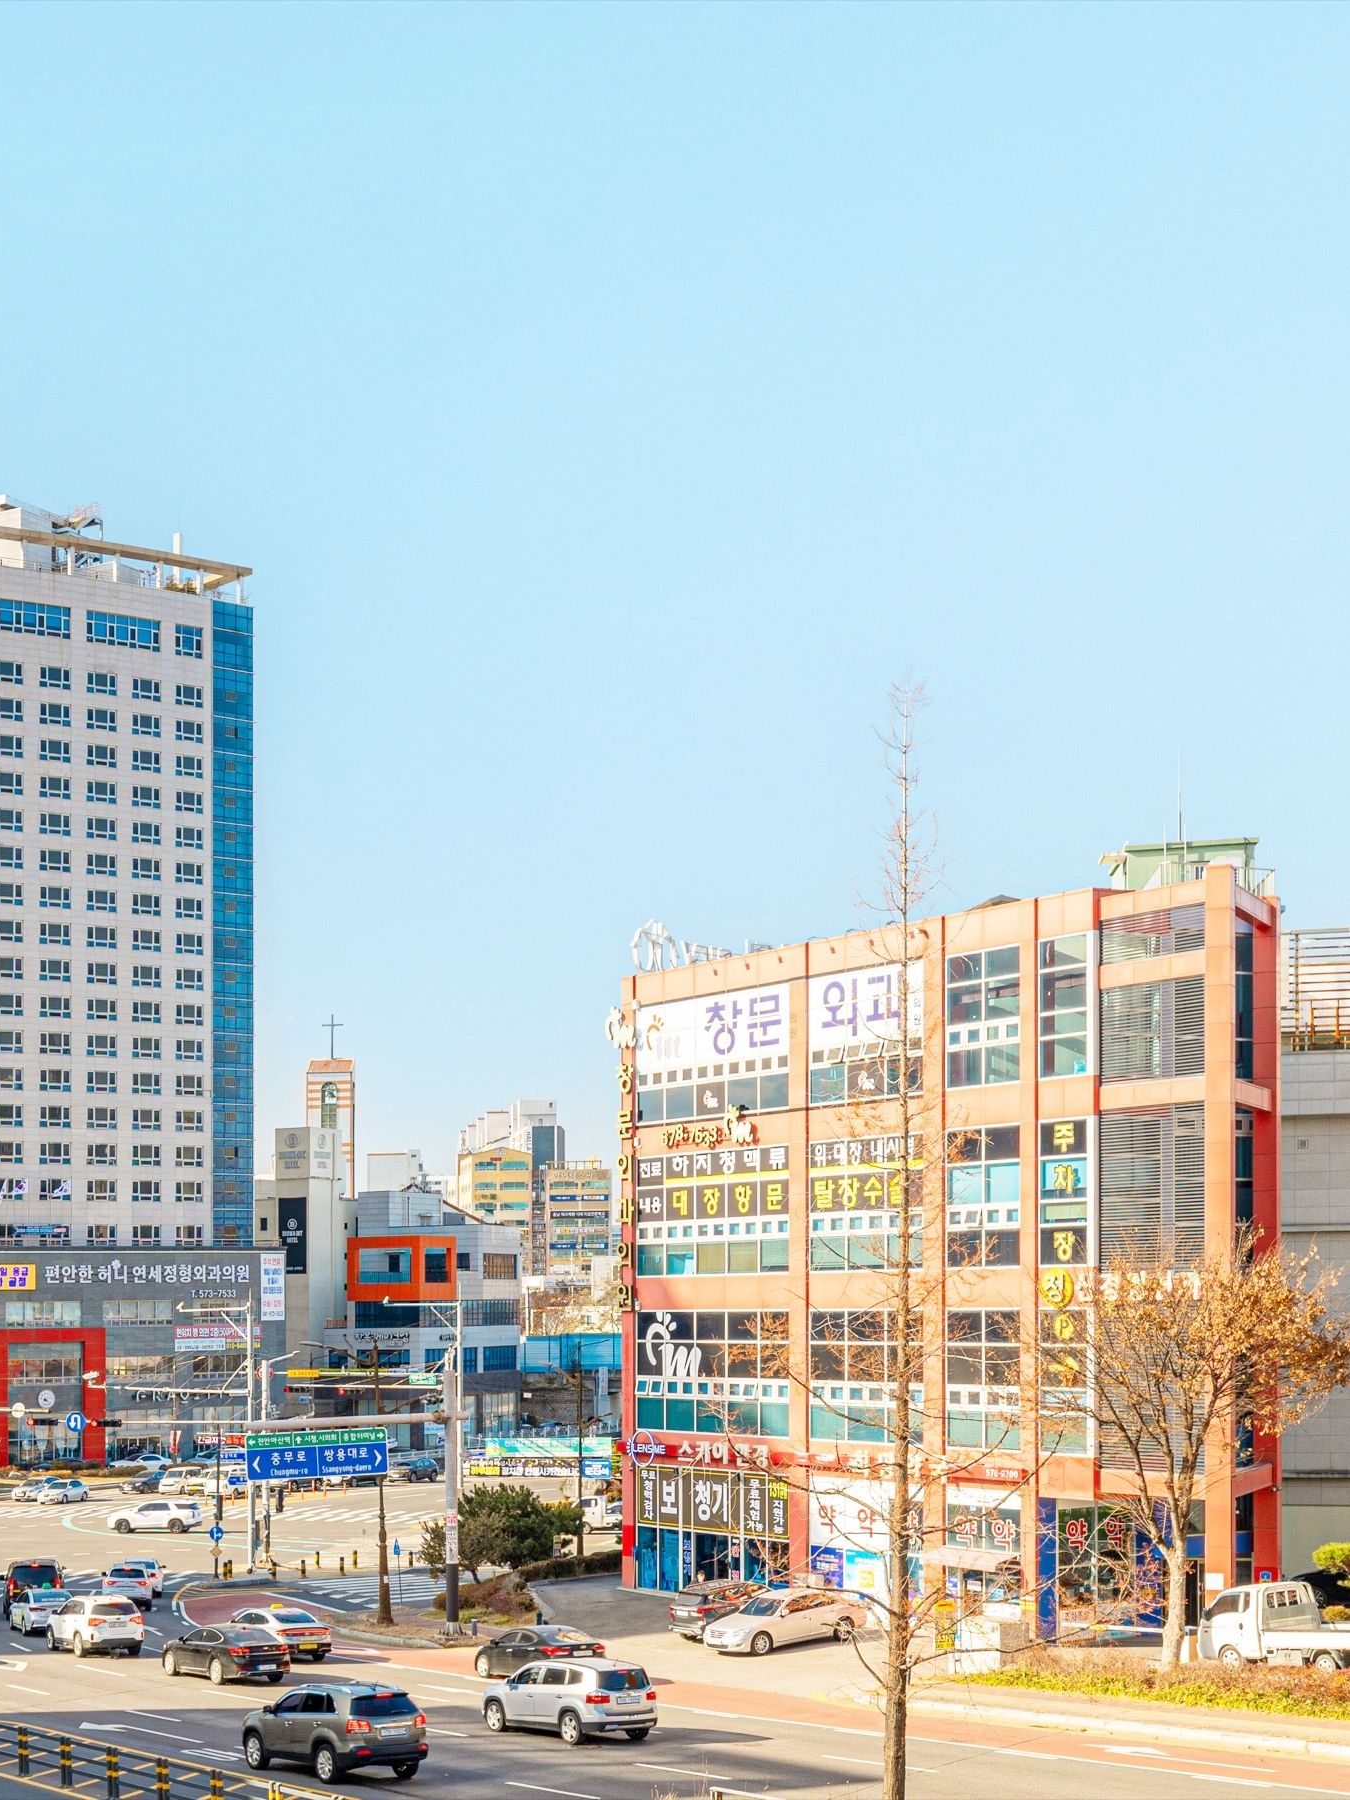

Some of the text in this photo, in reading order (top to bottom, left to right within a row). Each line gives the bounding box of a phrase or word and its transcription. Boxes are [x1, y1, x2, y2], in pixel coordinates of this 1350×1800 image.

[704, 975, 902, 1055] 창문 외과
[639, 1183, 783, 1216] 내용 대장항문
[1052, 1122, 1075, 1263] 주차장
[12, 1266, 30, 1276] 응급
[45, 1265, 93, 1283] 편안한
[133, 1264, 251, 1283] 연세정형외과의원
[191, 1289, 237, 1298] T.573-7533
[342, 1431, 376, 1441] 종합터미널
[270, 1447, 370, 1466] 충무로 쌍용대로
[677, 1440, 728, 1466] 스카이
[270, 1463, 373, 1477] Chungmu-ro Ssangyong-daero
[643, 1481, 655, 1521] 청력검사
[660, 1479, 729, 1523] 보청기
[954, 1515, 978, 1550] 약
[992, 1519, 1017, 1552] 약
[1066, 1518, 1089, 1553] 약
